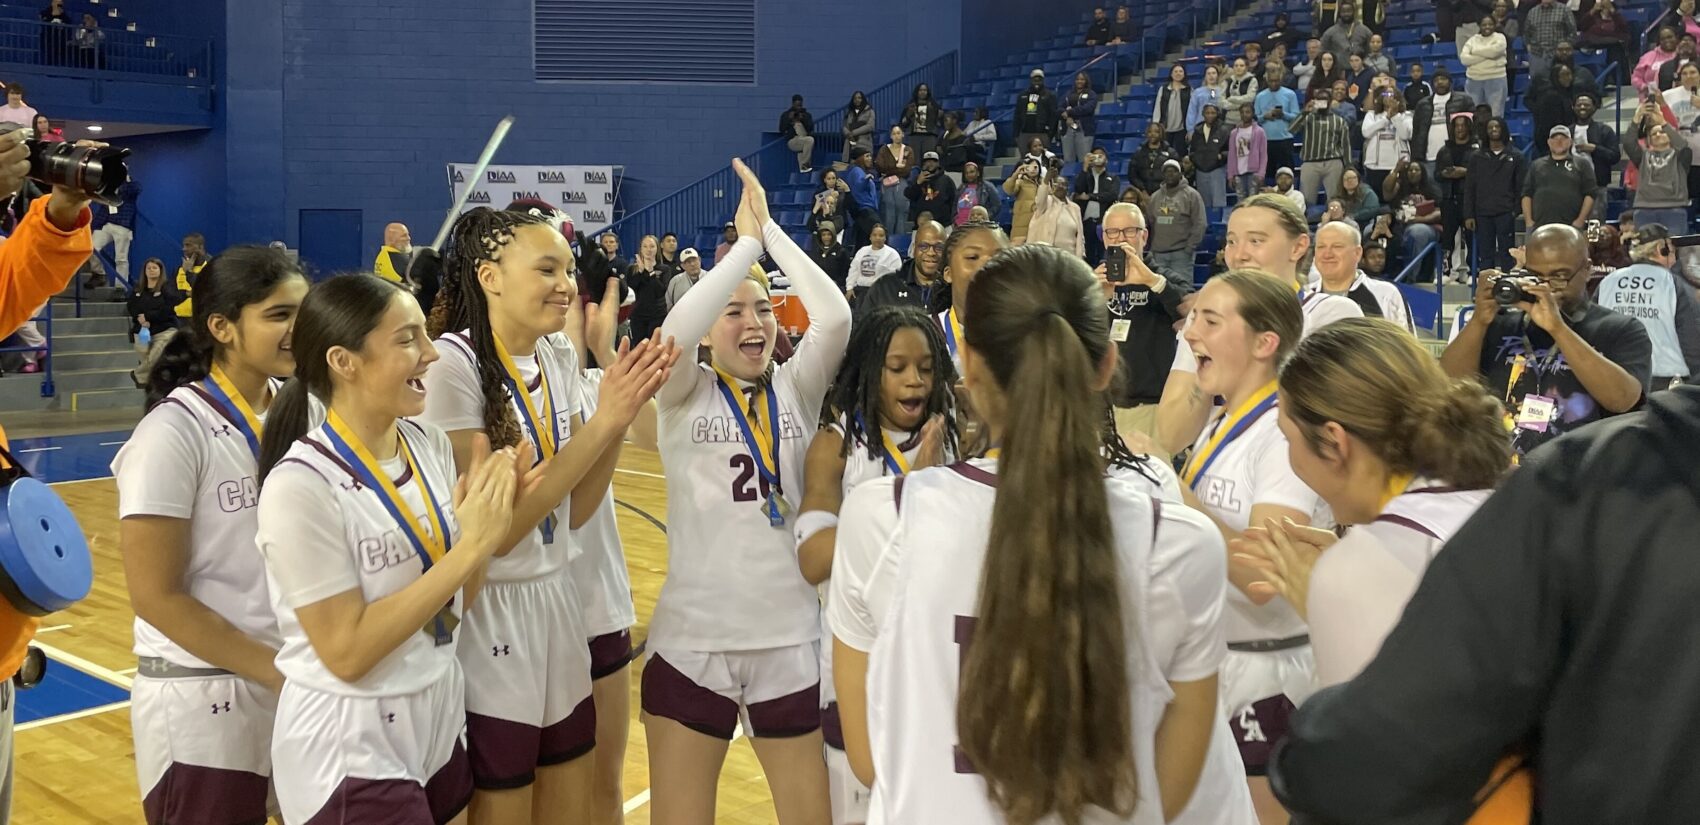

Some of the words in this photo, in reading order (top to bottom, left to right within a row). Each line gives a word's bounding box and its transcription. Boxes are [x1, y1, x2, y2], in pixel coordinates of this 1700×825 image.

[487, 170, 516, 181] DIAA
[538, 170, 565, 181] DIAA
[584, 170, 607, 182] DIAA
[562, 190, 587, 201] DIAA
[583, 209, 605, 221] DIAA
[1618, 276, 1655, 290] CSC
[1615, 291, 1654, 305] EVENT
